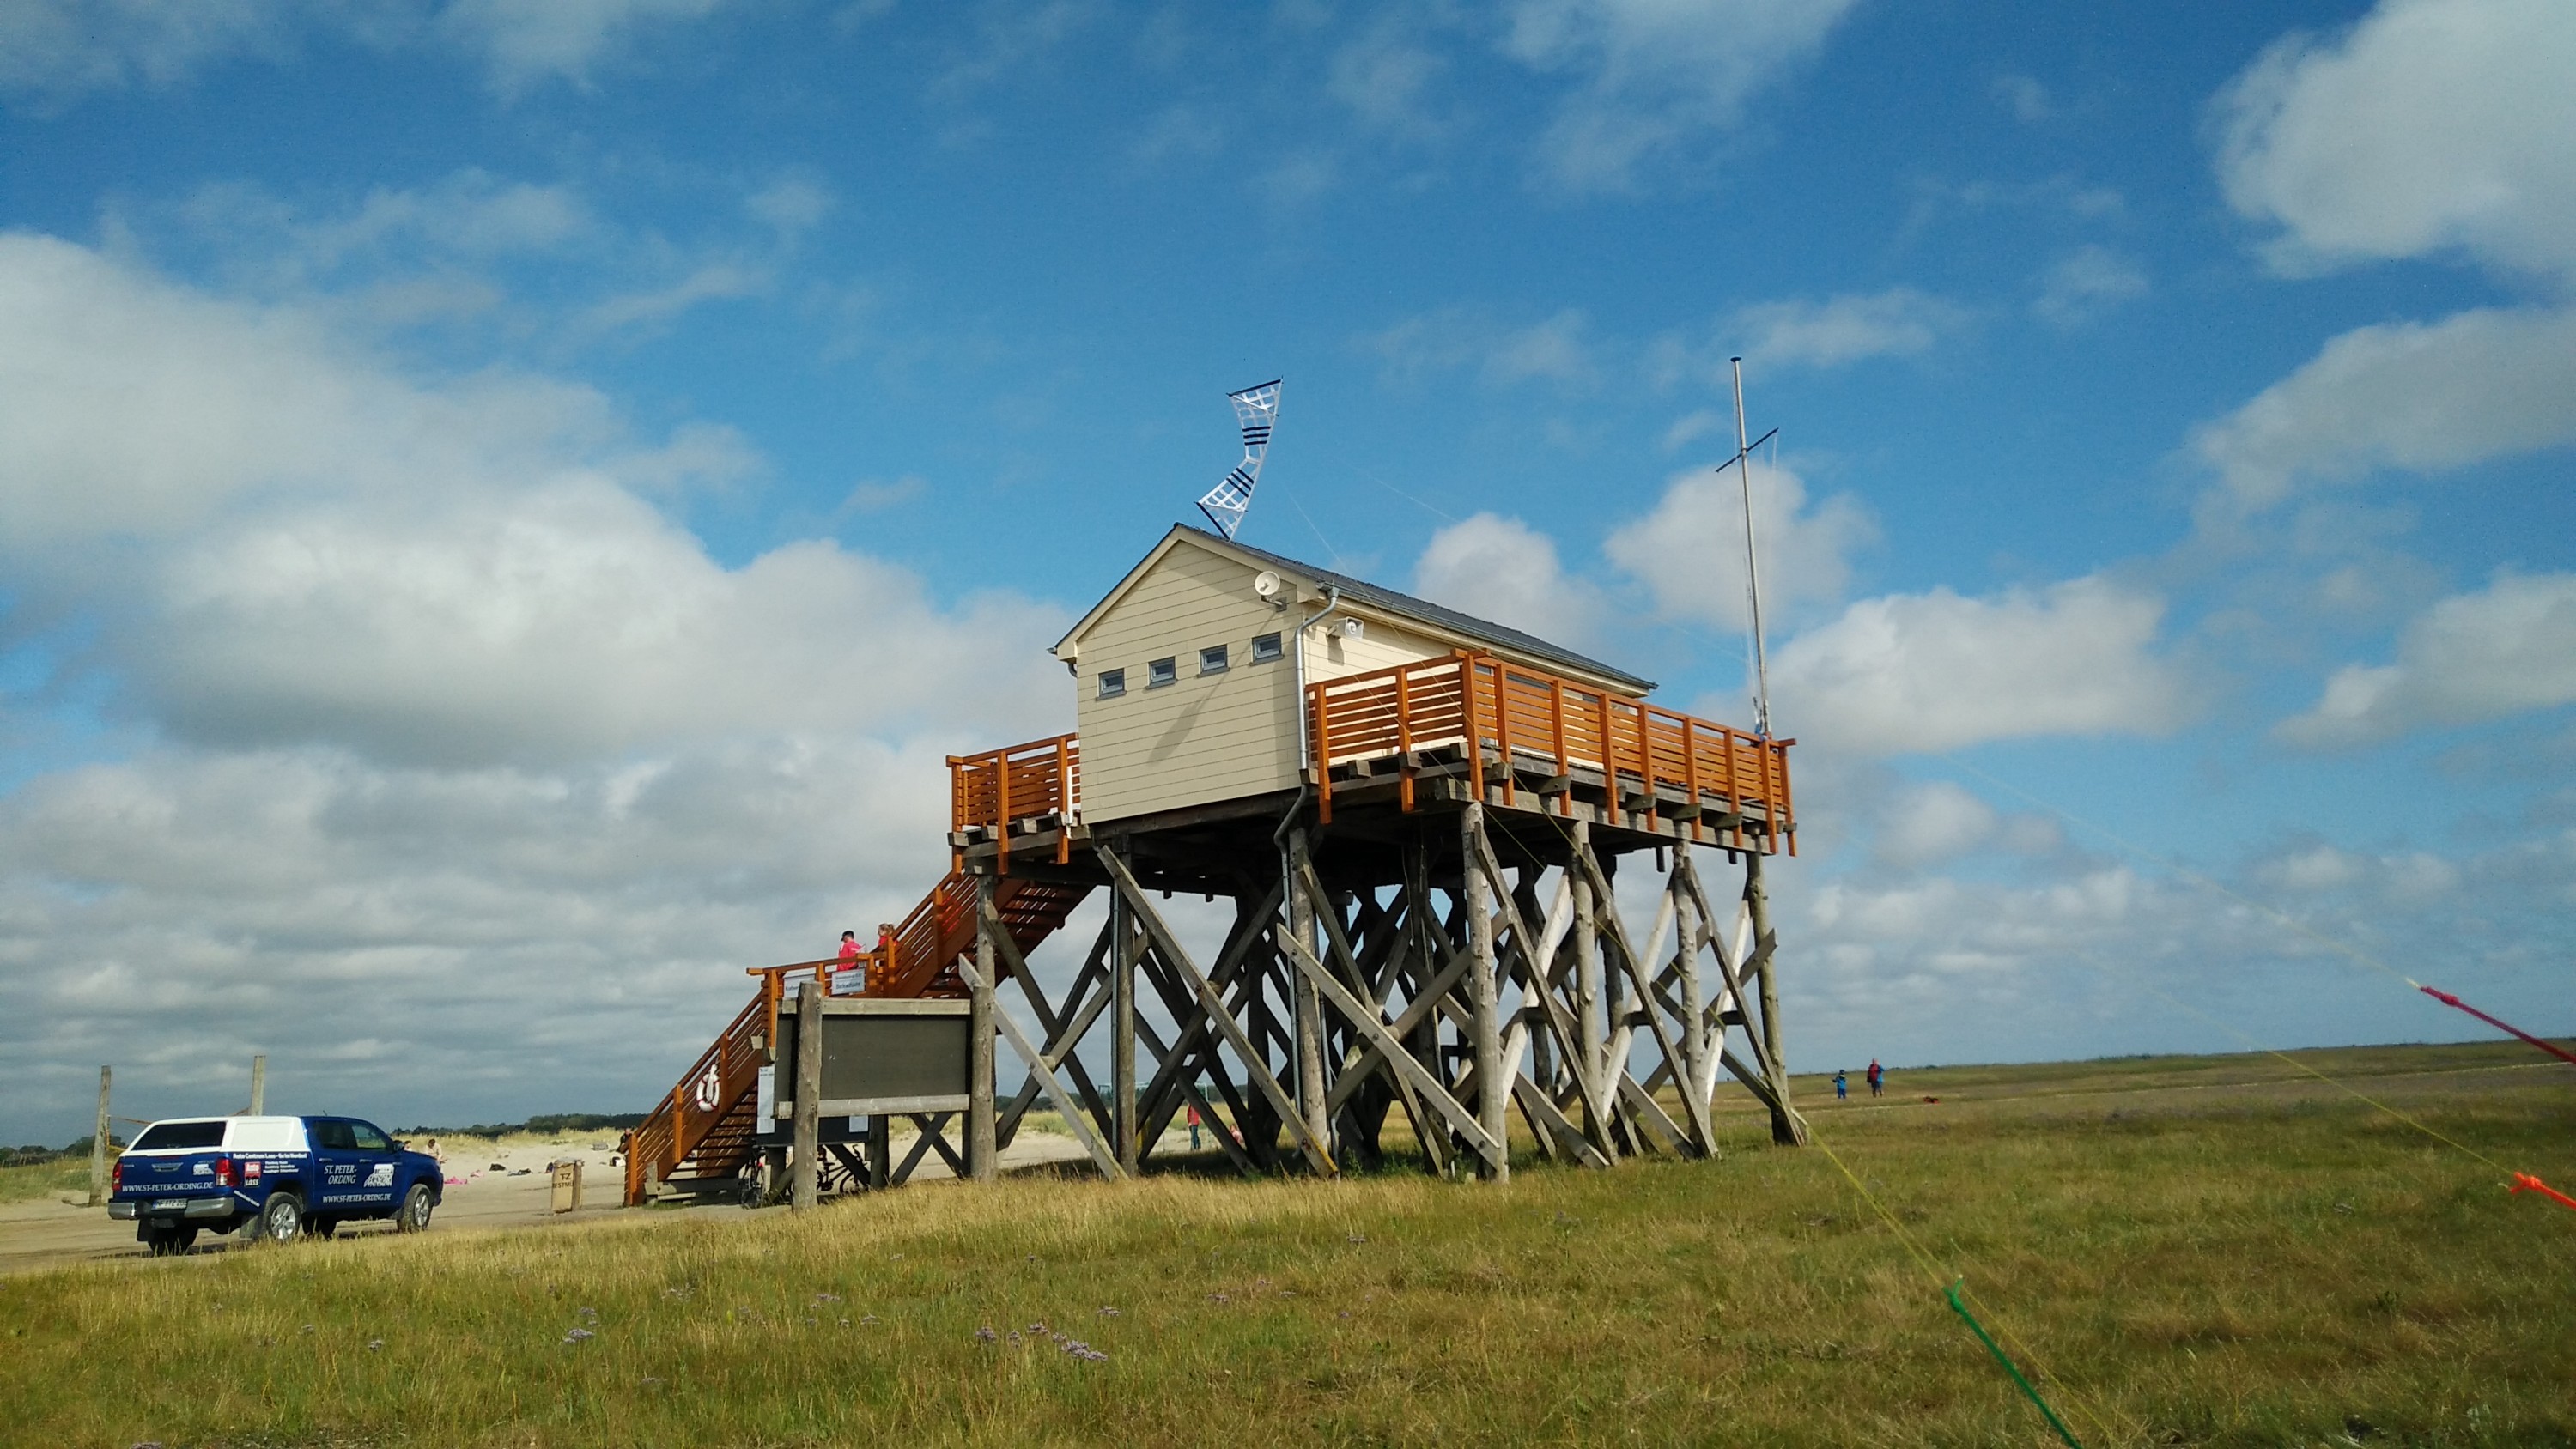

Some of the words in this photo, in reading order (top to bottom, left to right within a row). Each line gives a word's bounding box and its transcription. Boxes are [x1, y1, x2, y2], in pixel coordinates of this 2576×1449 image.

[324, 1165, 334, 1174] ST.
[335, 1164, 357, 1174] PETER-
[328, 1175, 356, 1185] ORDING
[122, 1182, 214, 1192] WWW.ST-PETER-ORDING.DE
[323, 1193, 392, 1203] WWW.ST-PETER-ORDING.DE
